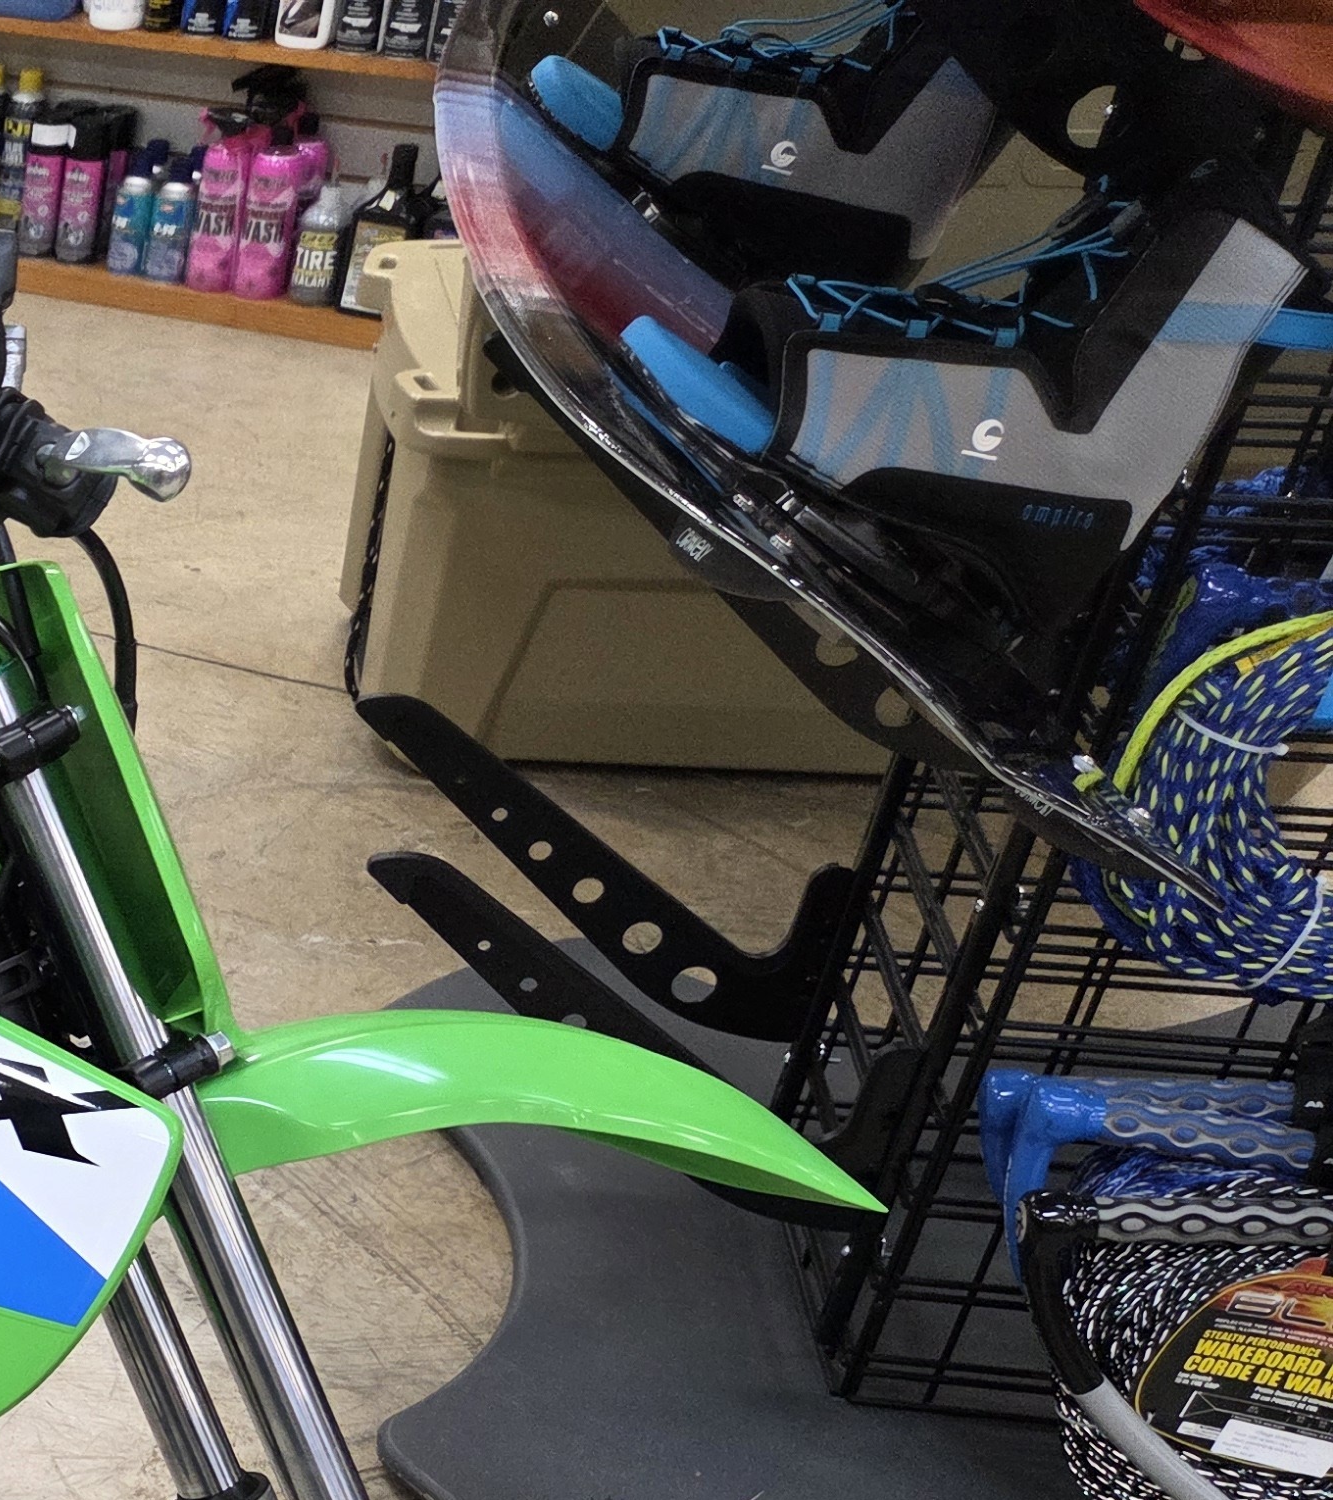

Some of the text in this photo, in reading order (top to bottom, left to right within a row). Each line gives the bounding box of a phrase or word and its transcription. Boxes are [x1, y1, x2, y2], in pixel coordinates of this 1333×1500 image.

[296, 247, 337, 270] TIRE
[1193, 1339, 1325, 1377] WAKEBOARD
[1202, 1329, 1322, 1358] STEALTH PERFORMANCE
[1184, 1355, 1254, 1381] CORDE
[1253, 1368, 1285, 1387] DE
